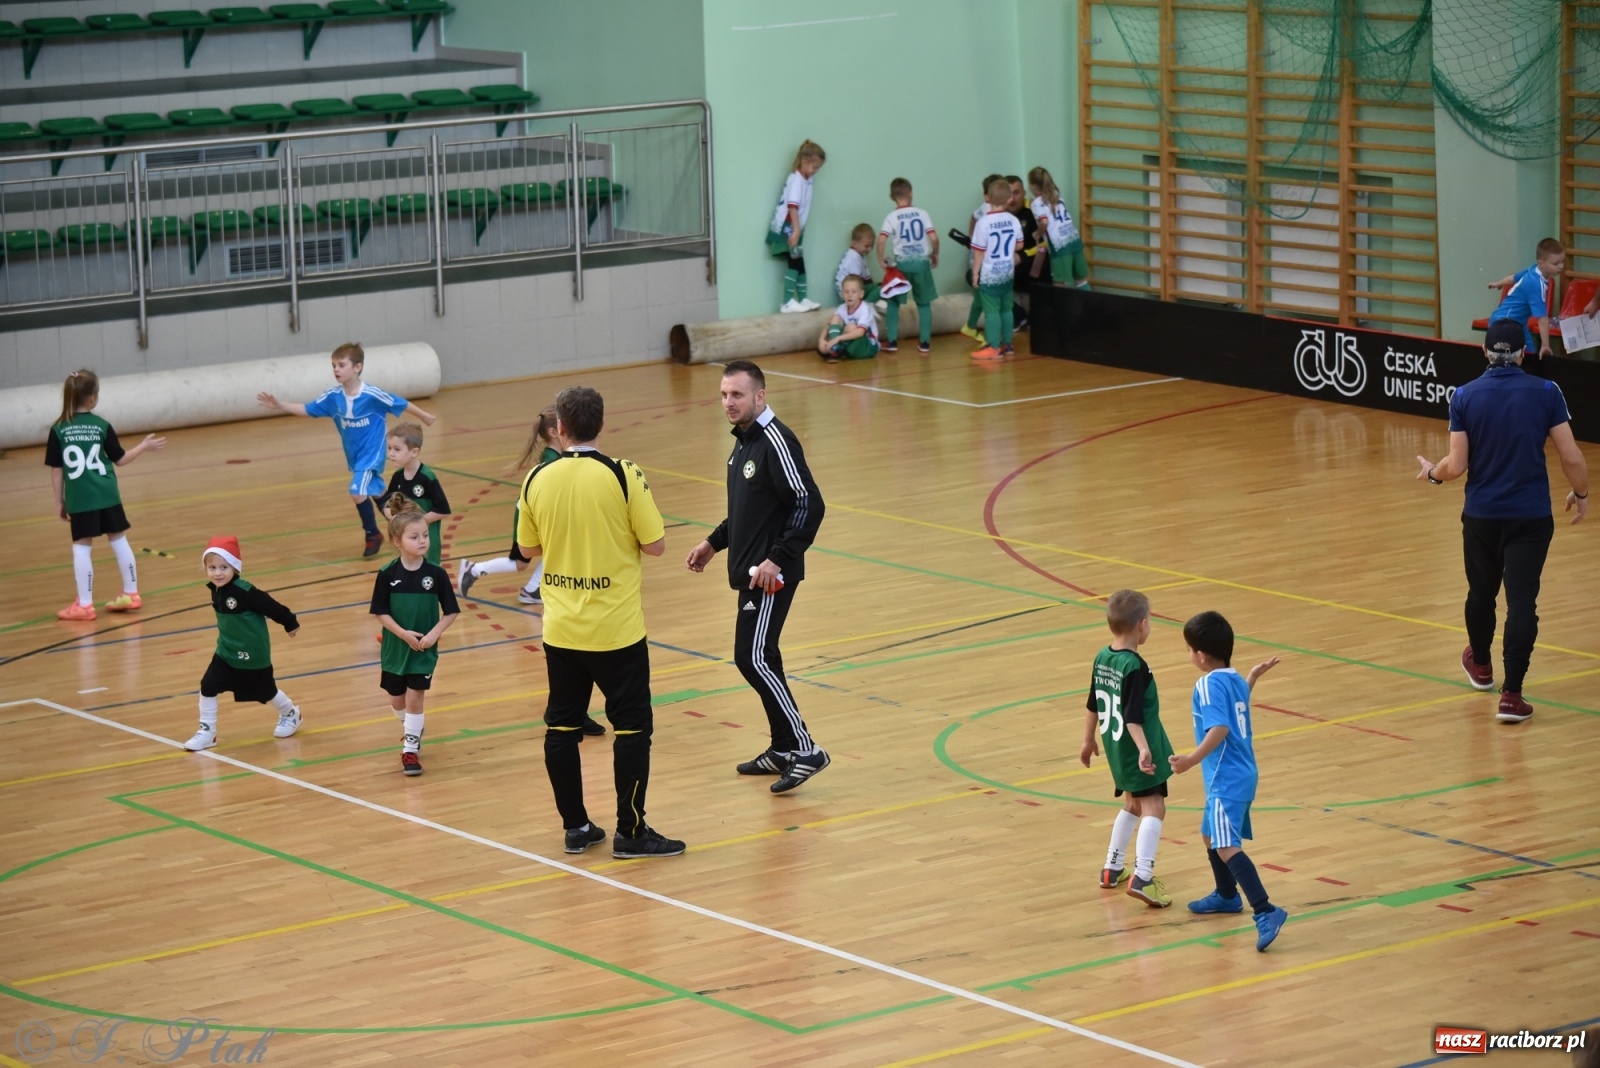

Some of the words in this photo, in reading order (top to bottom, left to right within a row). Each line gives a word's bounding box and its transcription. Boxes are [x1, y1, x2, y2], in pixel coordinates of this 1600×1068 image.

[900, 219, 924, 242] 40
[990, 220, 1012, 229] FABIAN
[989, 229, 1014, 259] 27
[1384, 346, 1437, 377] ČESKÁ
[1384, 376, 1423, 401] UNIE
[64, 433, 101, 443] TWORKÓW
[63, 443, 107, 480] 94
[544, 573, 611, 590] DORTMUND
[1095, 689, 1124, 741] 95
[1234, 701, 1247, 739] 6
